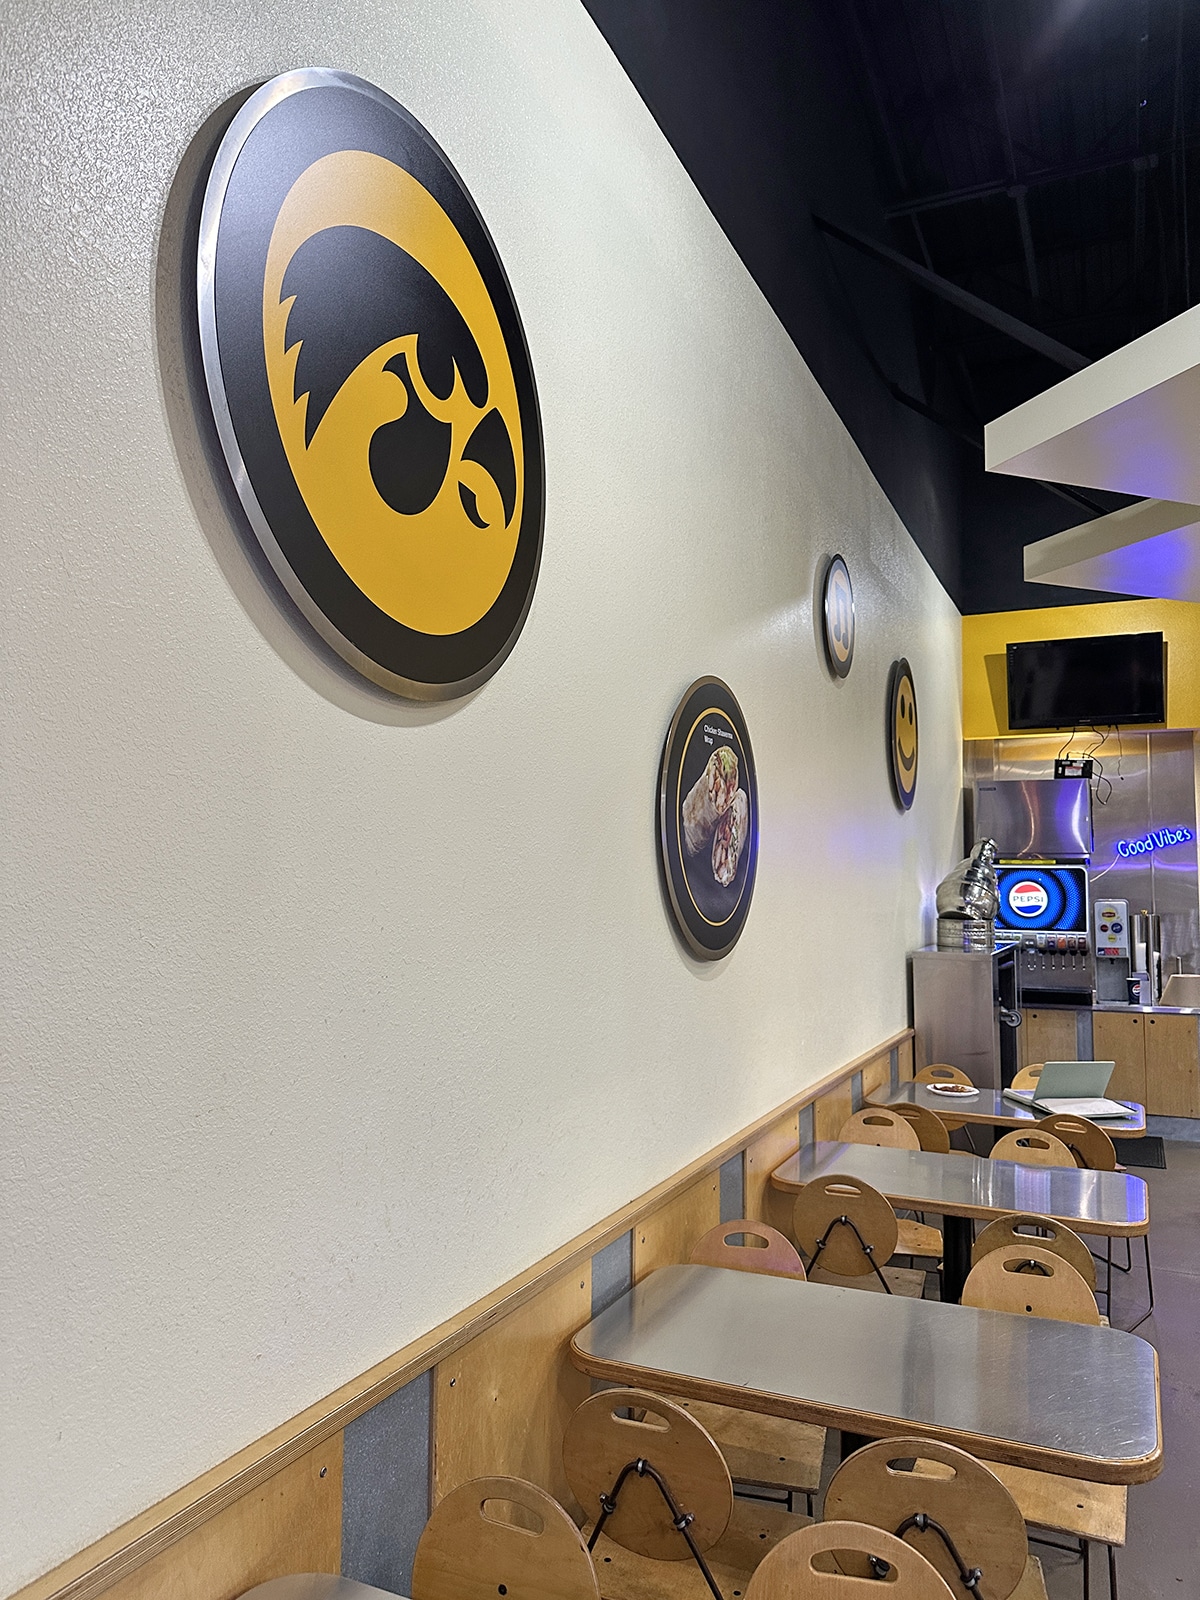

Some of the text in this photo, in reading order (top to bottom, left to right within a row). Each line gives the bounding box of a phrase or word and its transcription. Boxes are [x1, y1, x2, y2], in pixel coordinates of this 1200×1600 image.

[1117, 828, 1191, 857] Good Vibes
[1012, 895, 1044, 903] PEPSI
